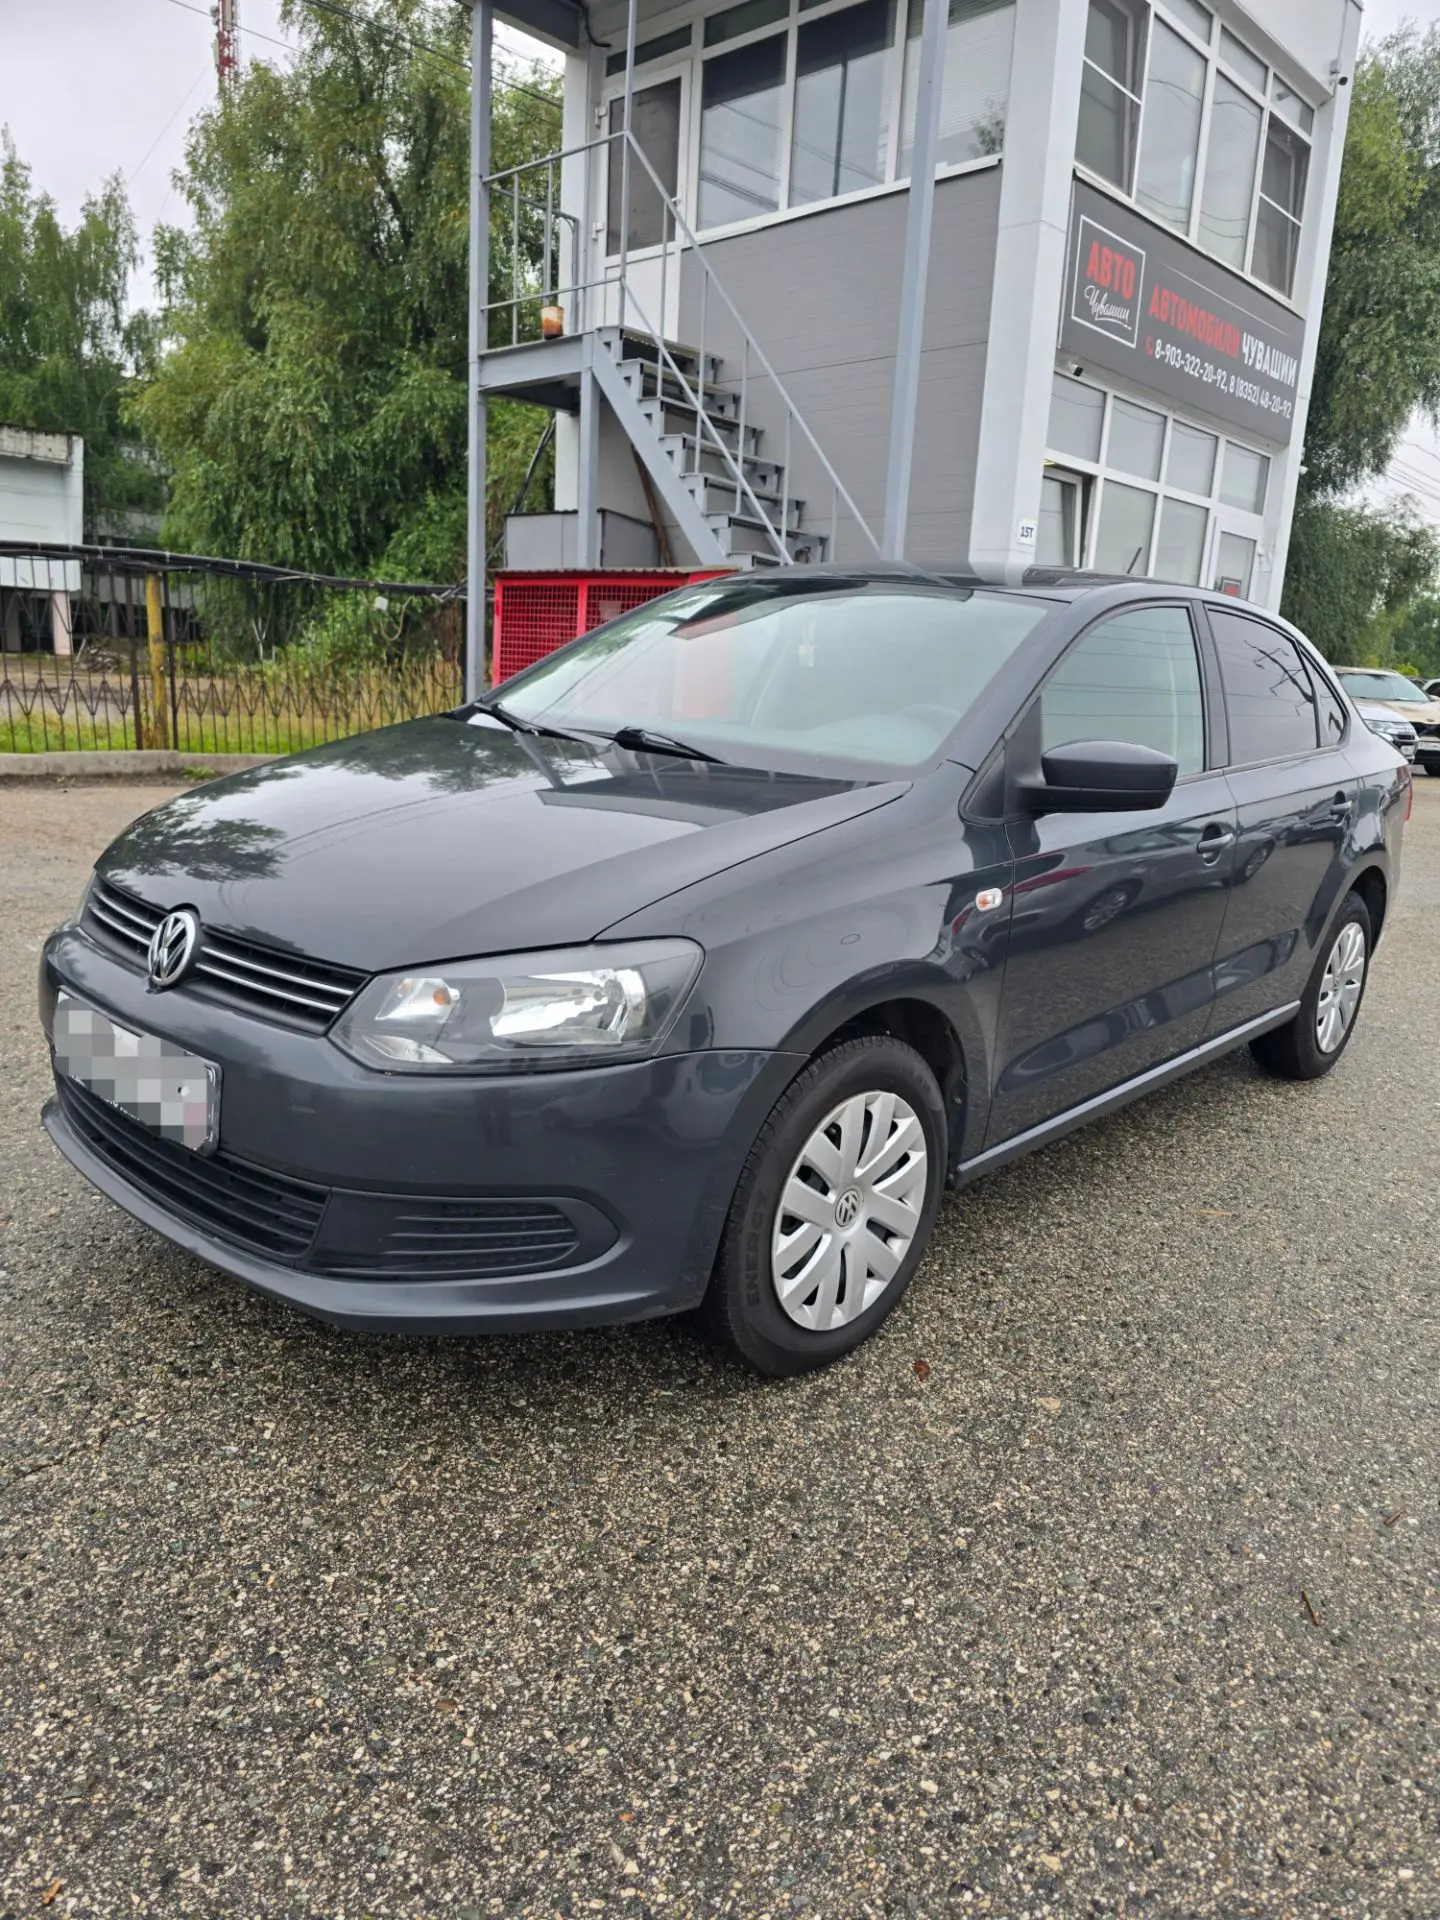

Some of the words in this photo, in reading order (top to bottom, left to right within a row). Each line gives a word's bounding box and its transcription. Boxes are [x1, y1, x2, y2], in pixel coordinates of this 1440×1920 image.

[1086, 239, 1135, 300] АВТО
[1148, 283, 1242, 359] АВТОМОБИЛИ
[1242, 332, 1298, 388] ЧУВАШИИ
[1154, 339, 1228, 393] 8-903-322-20-92,
[1229, 375, 1236, 393] 8
[1260, 391, 1292, 419] 48-20-92
